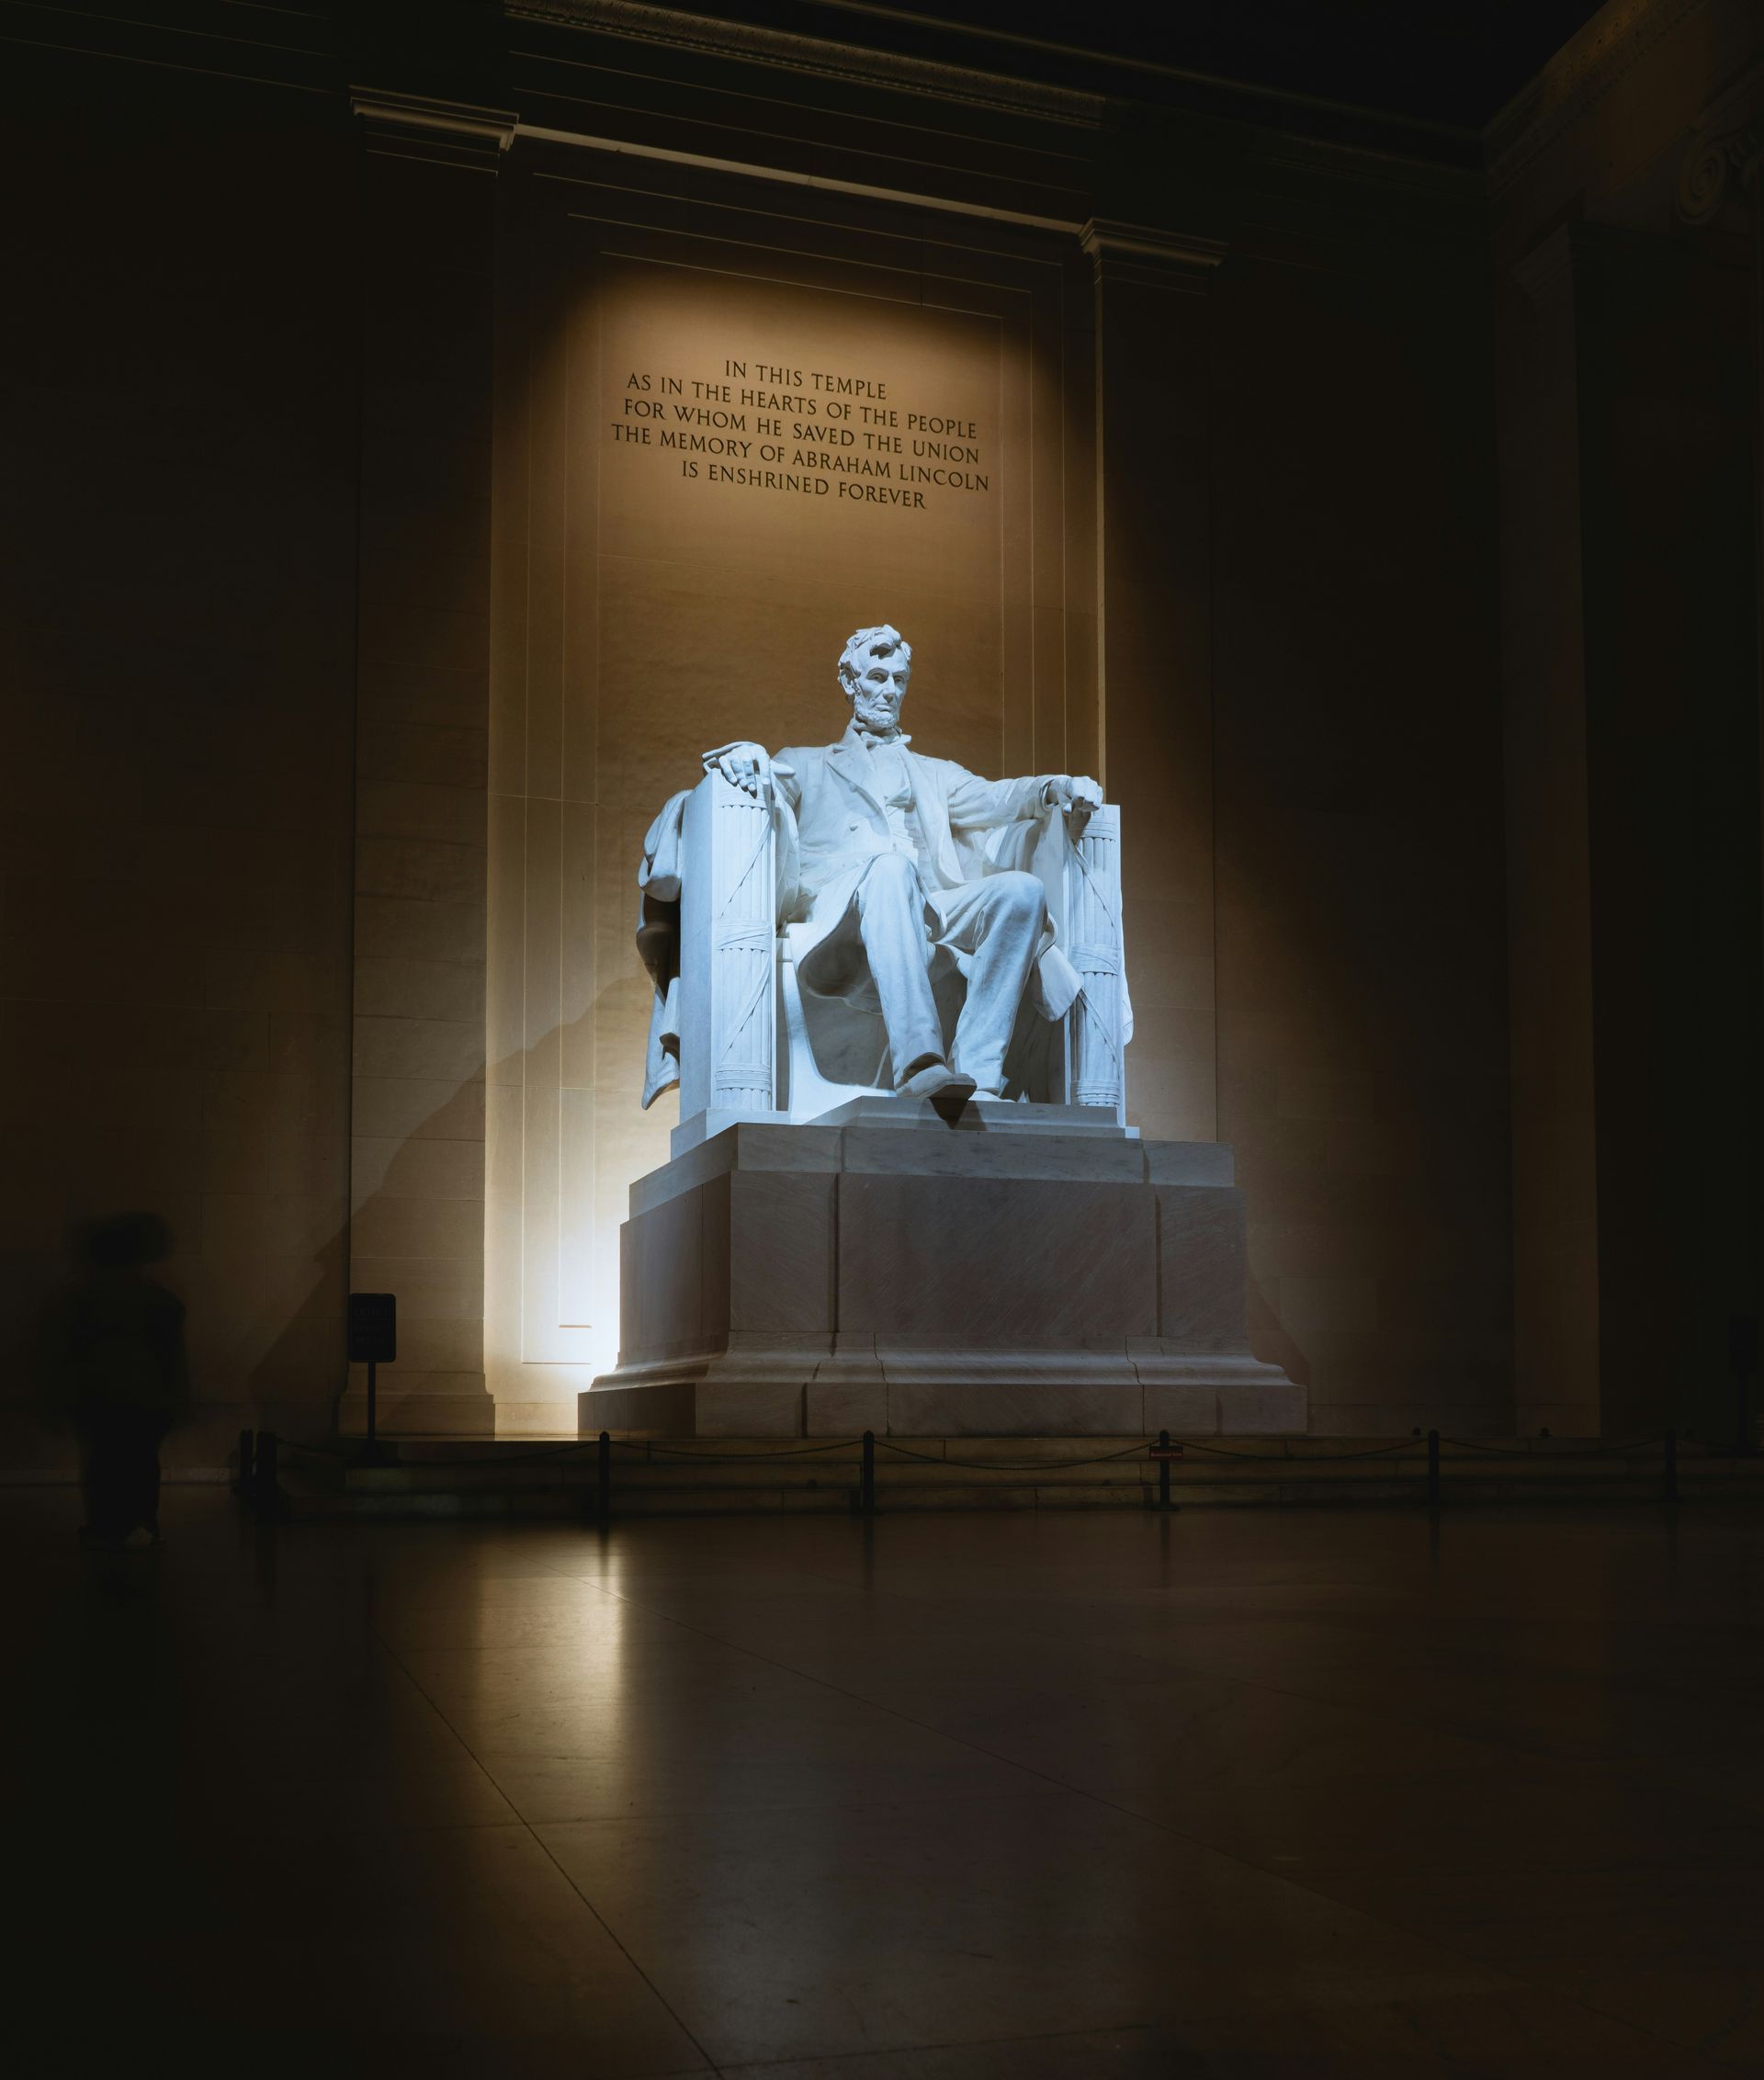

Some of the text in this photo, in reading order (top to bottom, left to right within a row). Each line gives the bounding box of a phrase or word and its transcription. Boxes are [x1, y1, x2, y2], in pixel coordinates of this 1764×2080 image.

[627, 372, 977, 440] AS IN THE HEARTS OF THE PEOPLE
[725, 359, 888, 401] IN THIS TEMPLE
[610, 423, 989, 492] THE MEMORY OF ABRAHAM LINCOLN
[624, 398, 979, 465] FOR WHOM HE SAVED THE UNION
[682, 459, 927, 510] IS ENSHRINED FOREVER
